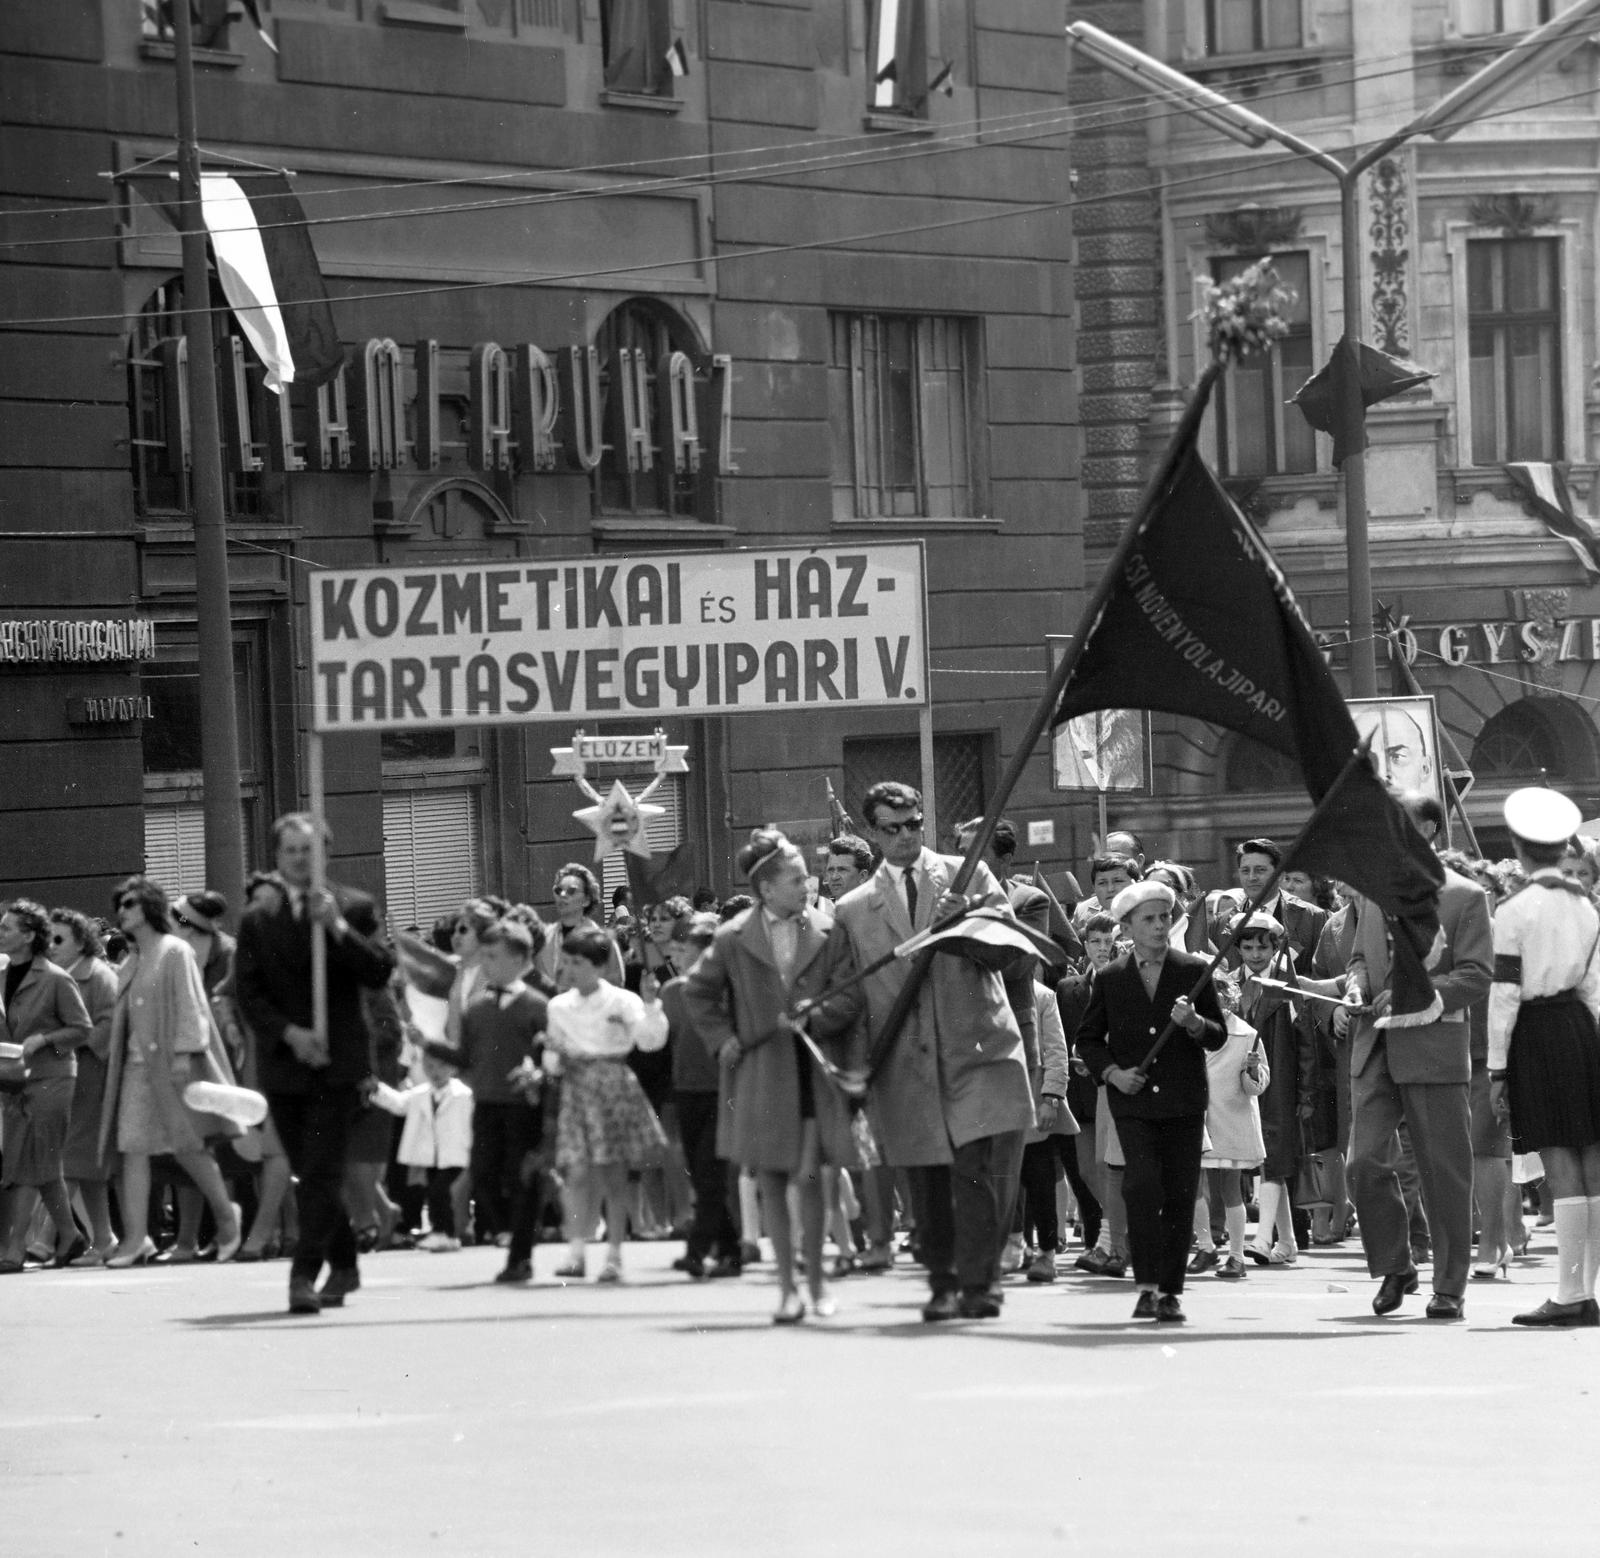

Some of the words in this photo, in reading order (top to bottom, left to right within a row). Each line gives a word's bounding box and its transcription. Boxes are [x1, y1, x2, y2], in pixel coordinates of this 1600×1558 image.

[321, 562, 682, 640] KOZMETIKAI
[700, 591, 736, 624] ÉS
[754, 549, 896, 621] HÁZ-
[318, 637, 860, 723] TARTÁSVEGYIPARI
[875, 635, 917, 700] V.
